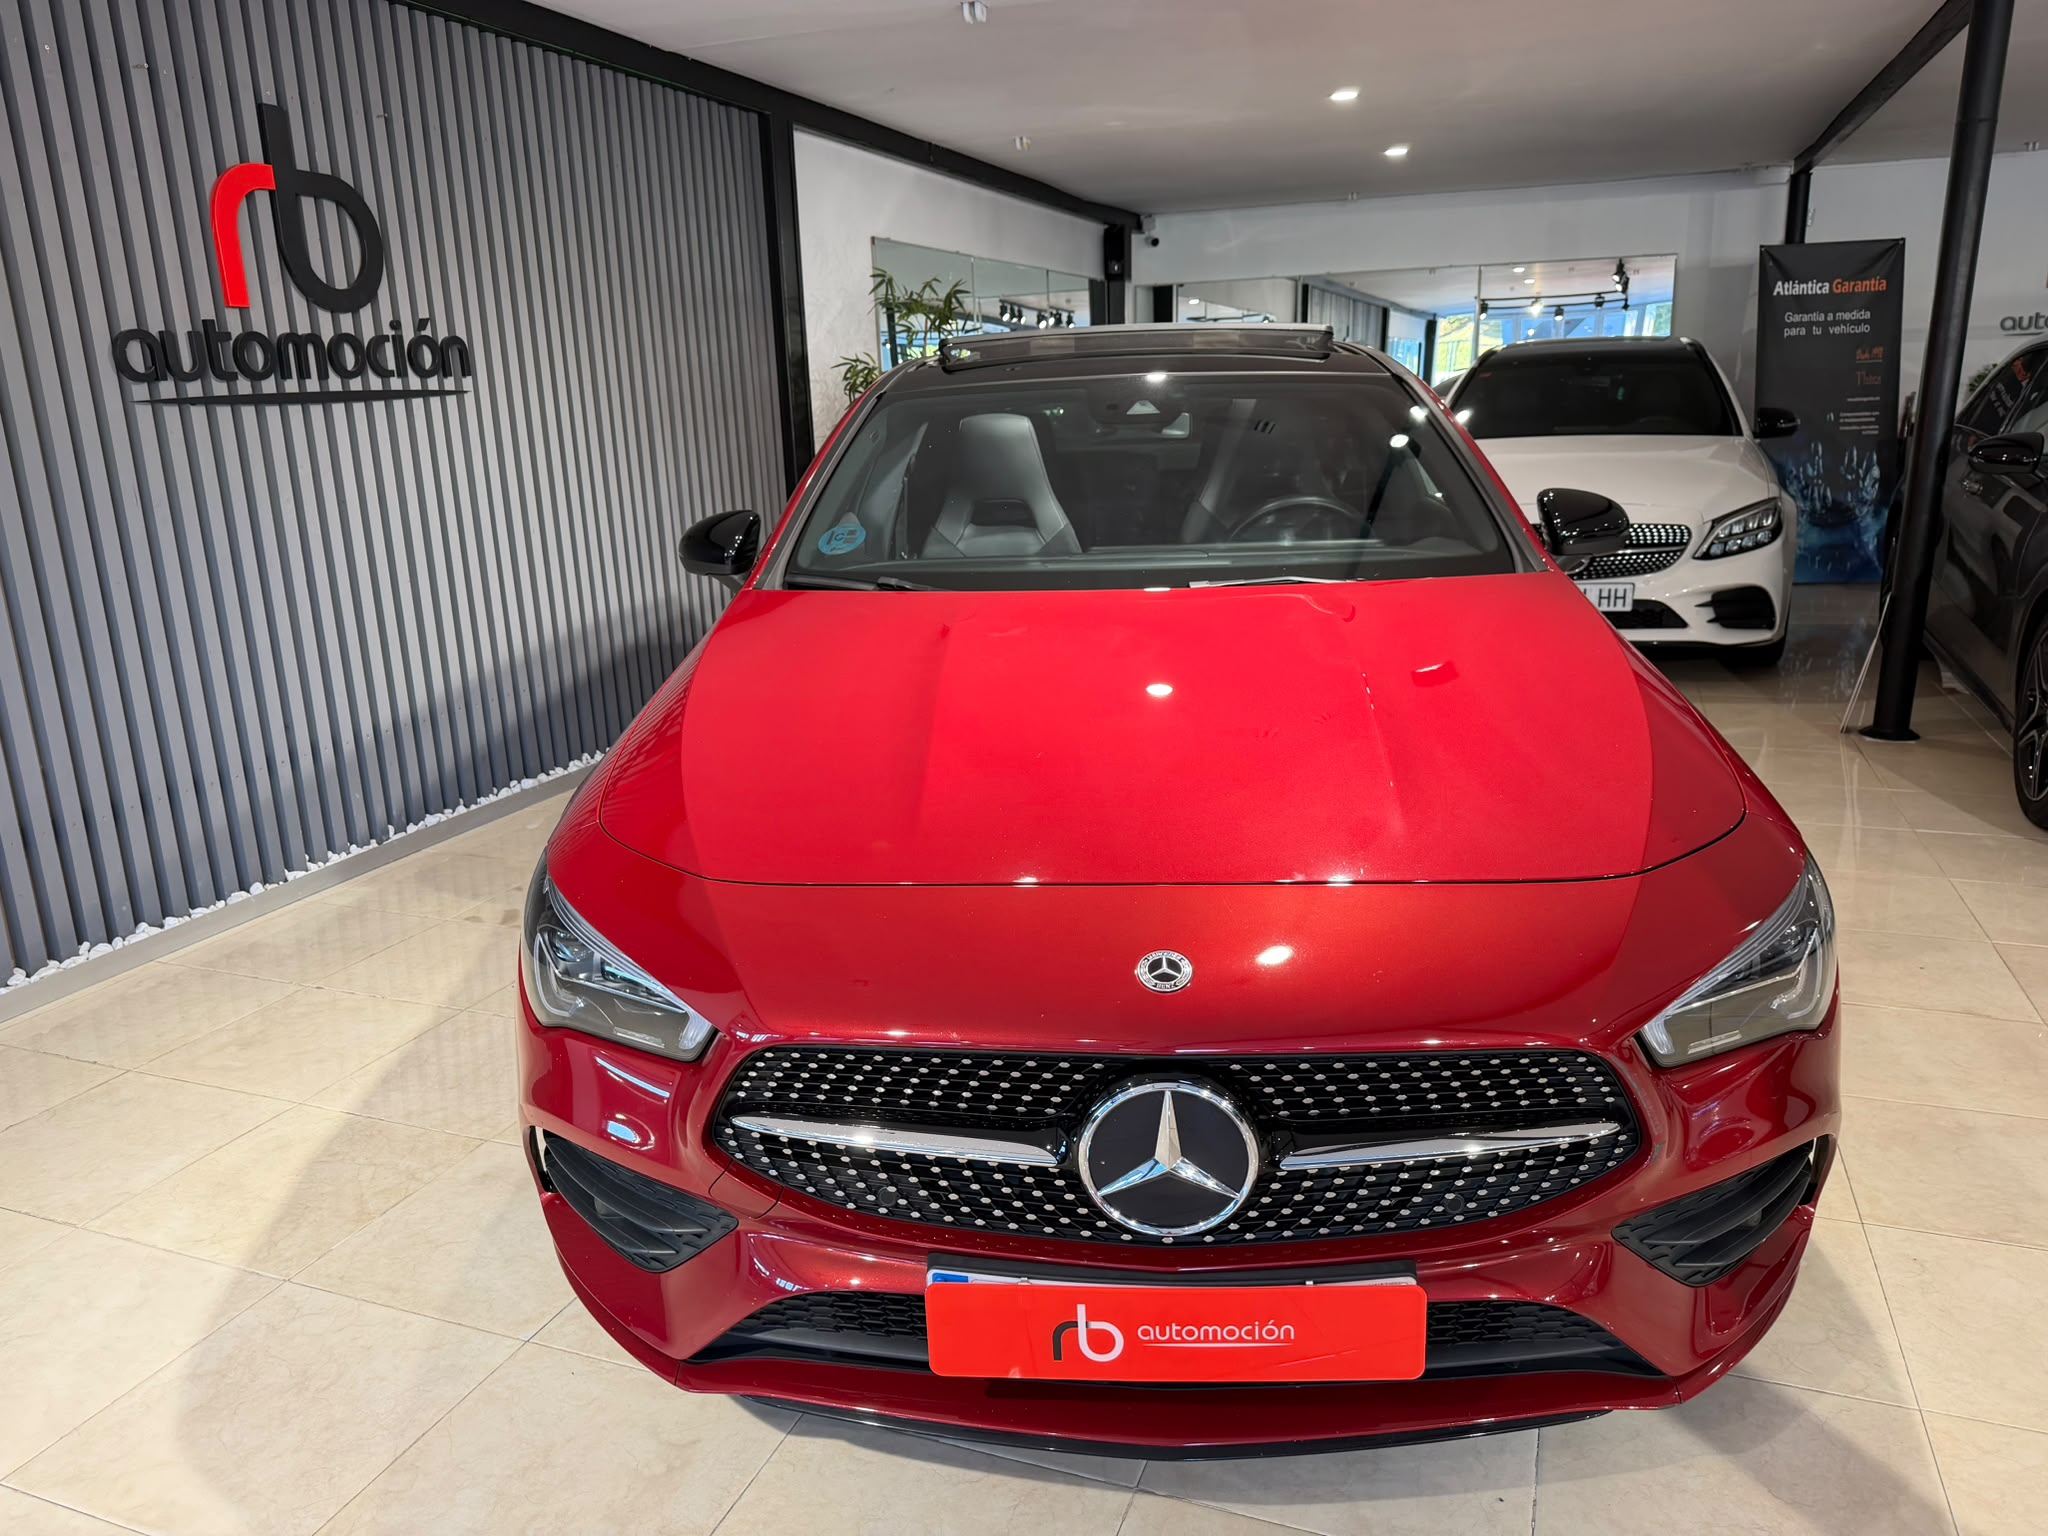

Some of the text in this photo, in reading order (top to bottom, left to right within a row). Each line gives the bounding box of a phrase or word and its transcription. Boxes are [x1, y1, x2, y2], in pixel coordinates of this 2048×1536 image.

[210, 102, 384, 314] rb
[1773, 276, 1887, 296] Atlántica Garantía
[1827, 312, 1833, 321] a
[1835, 309, 1871, 320] medida
[2000, 312, 2048, 331] aut
[1783, 326, 1806, 338] para
[1812, 324, 1822, 335] tu
[111, 317, 472, 383] automoción
[1052, 1304, 1295, 1363] rb automoción
